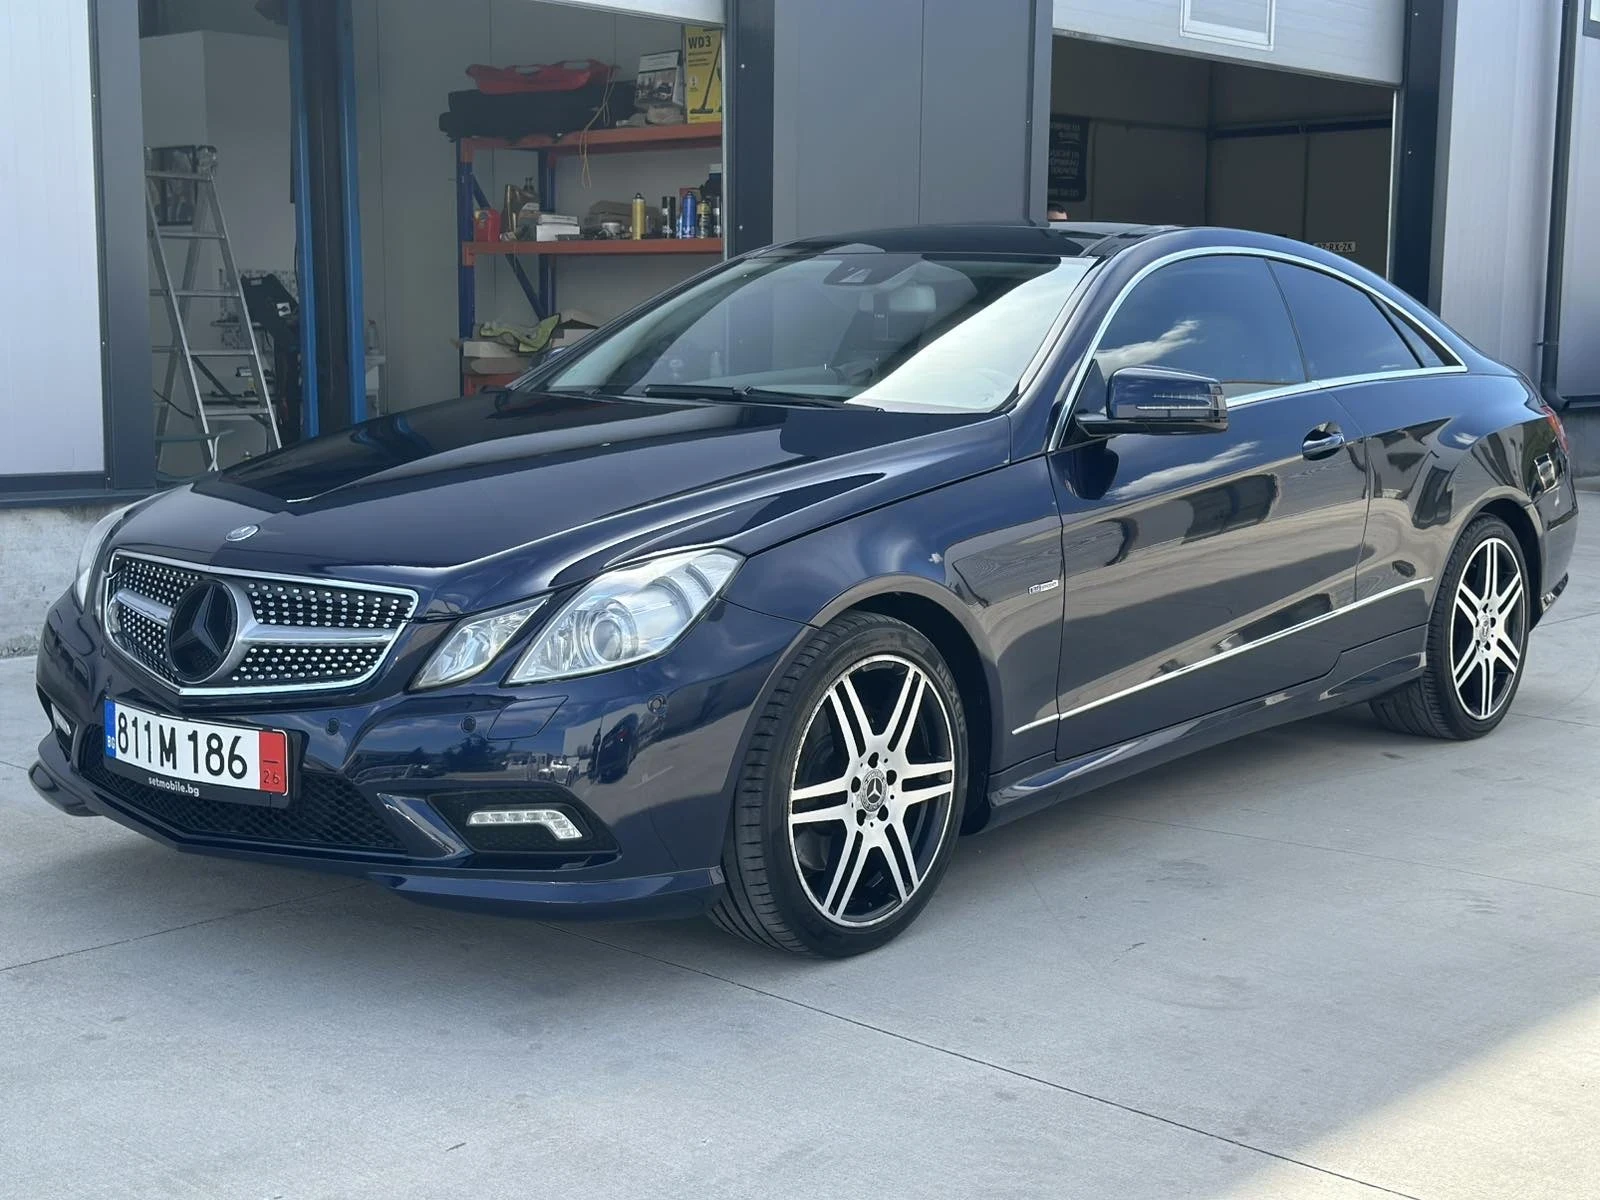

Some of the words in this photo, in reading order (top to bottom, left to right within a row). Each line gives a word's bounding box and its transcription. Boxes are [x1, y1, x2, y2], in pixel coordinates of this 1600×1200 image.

[107, 735, 116, 749] BG
[118, 712, 177, 770] 811M
[187, 729, 248, 780] 186
[263, 770, 280, 784] 26
[148, 776, 200, 797] setmobile.bg
